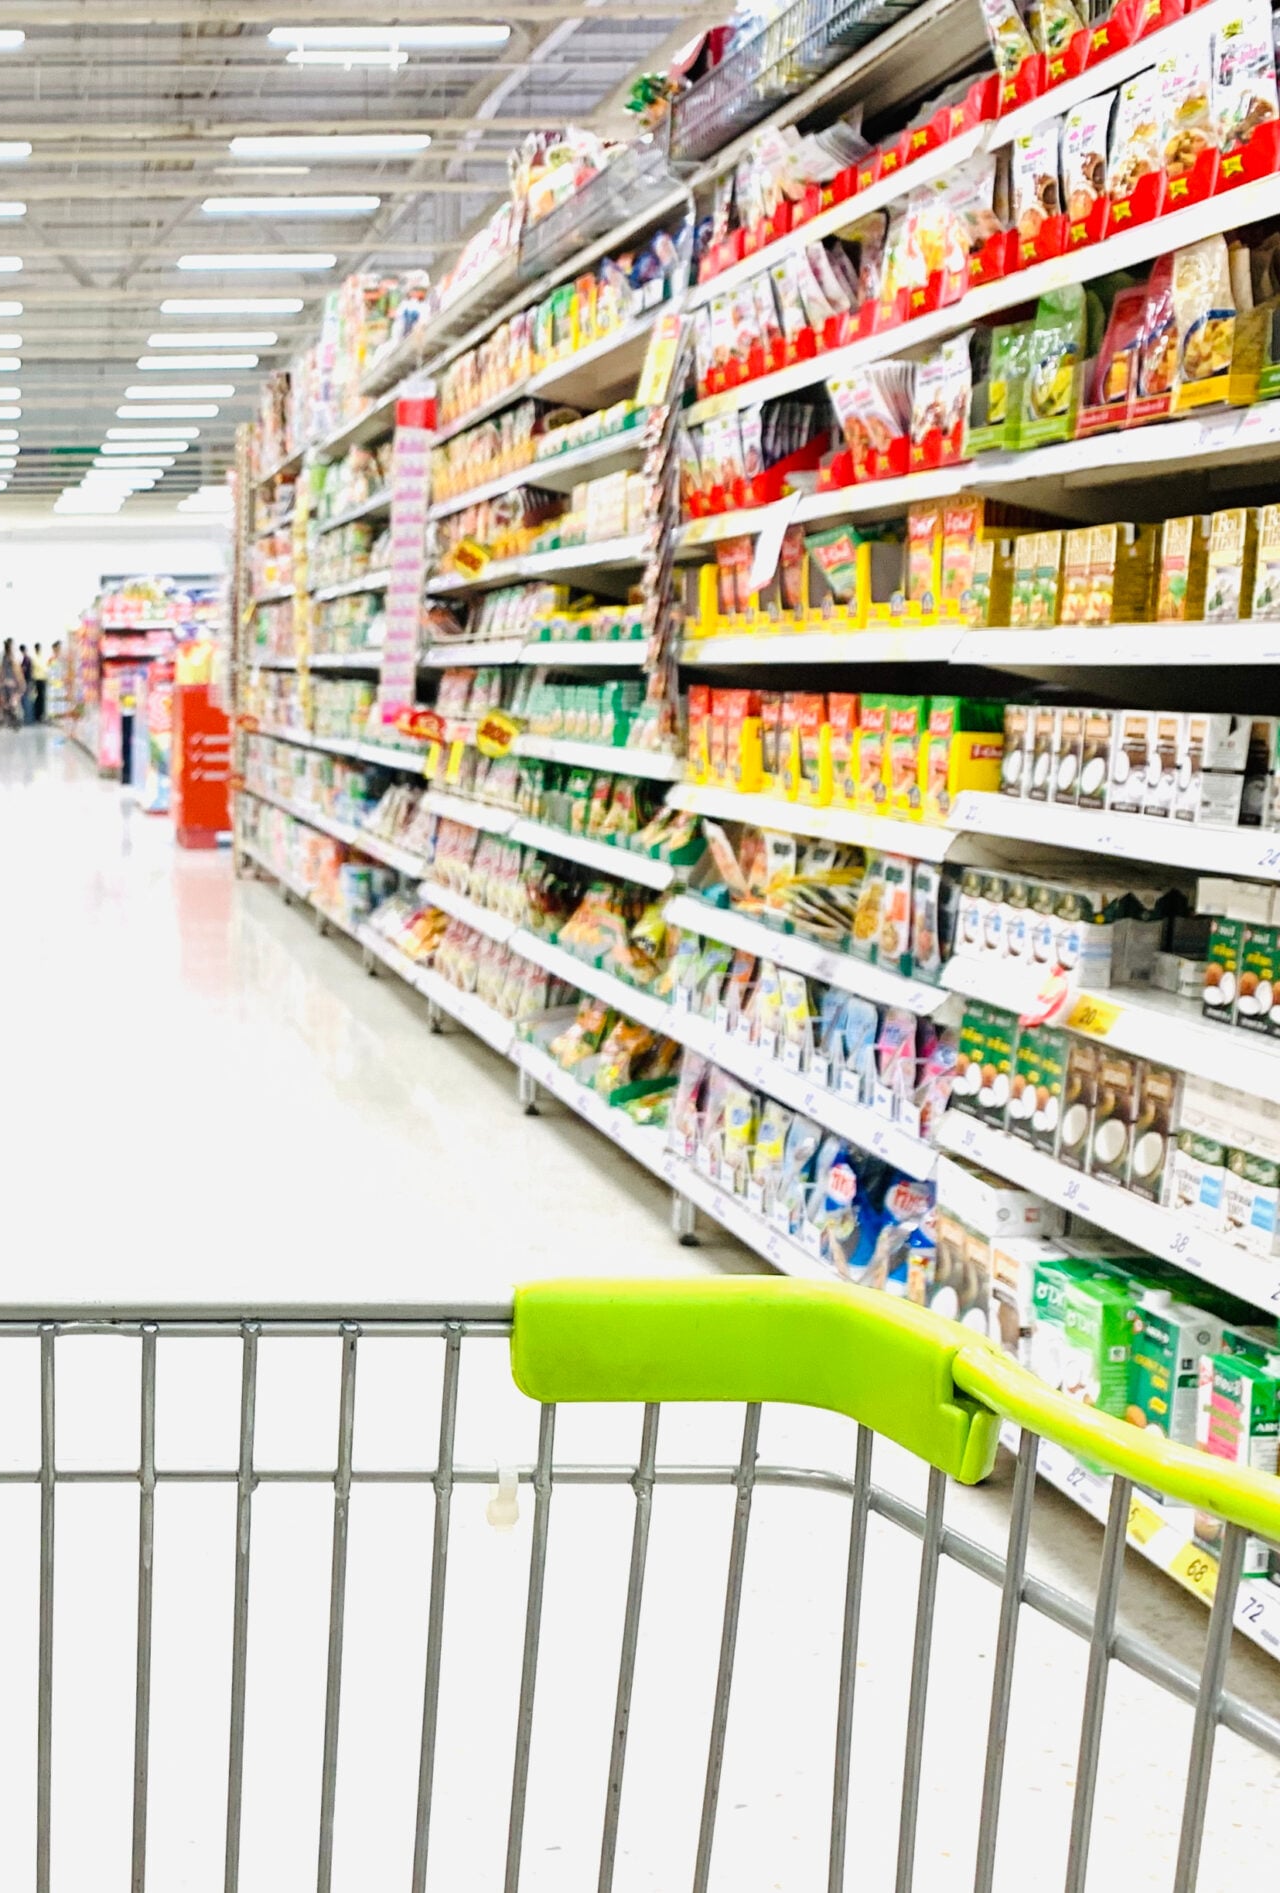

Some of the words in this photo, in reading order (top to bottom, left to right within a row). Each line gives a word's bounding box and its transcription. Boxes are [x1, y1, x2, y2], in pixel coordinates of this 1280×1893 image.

[1078, 1006, 1098, 1025] 20
[1169, 1232, 1190, 1254] 38
[1066, 1466, 1087, 1487] 82
[1186, 1559, 1209, 1583] 68
[1241, 1597, 1266, 1623] 72
